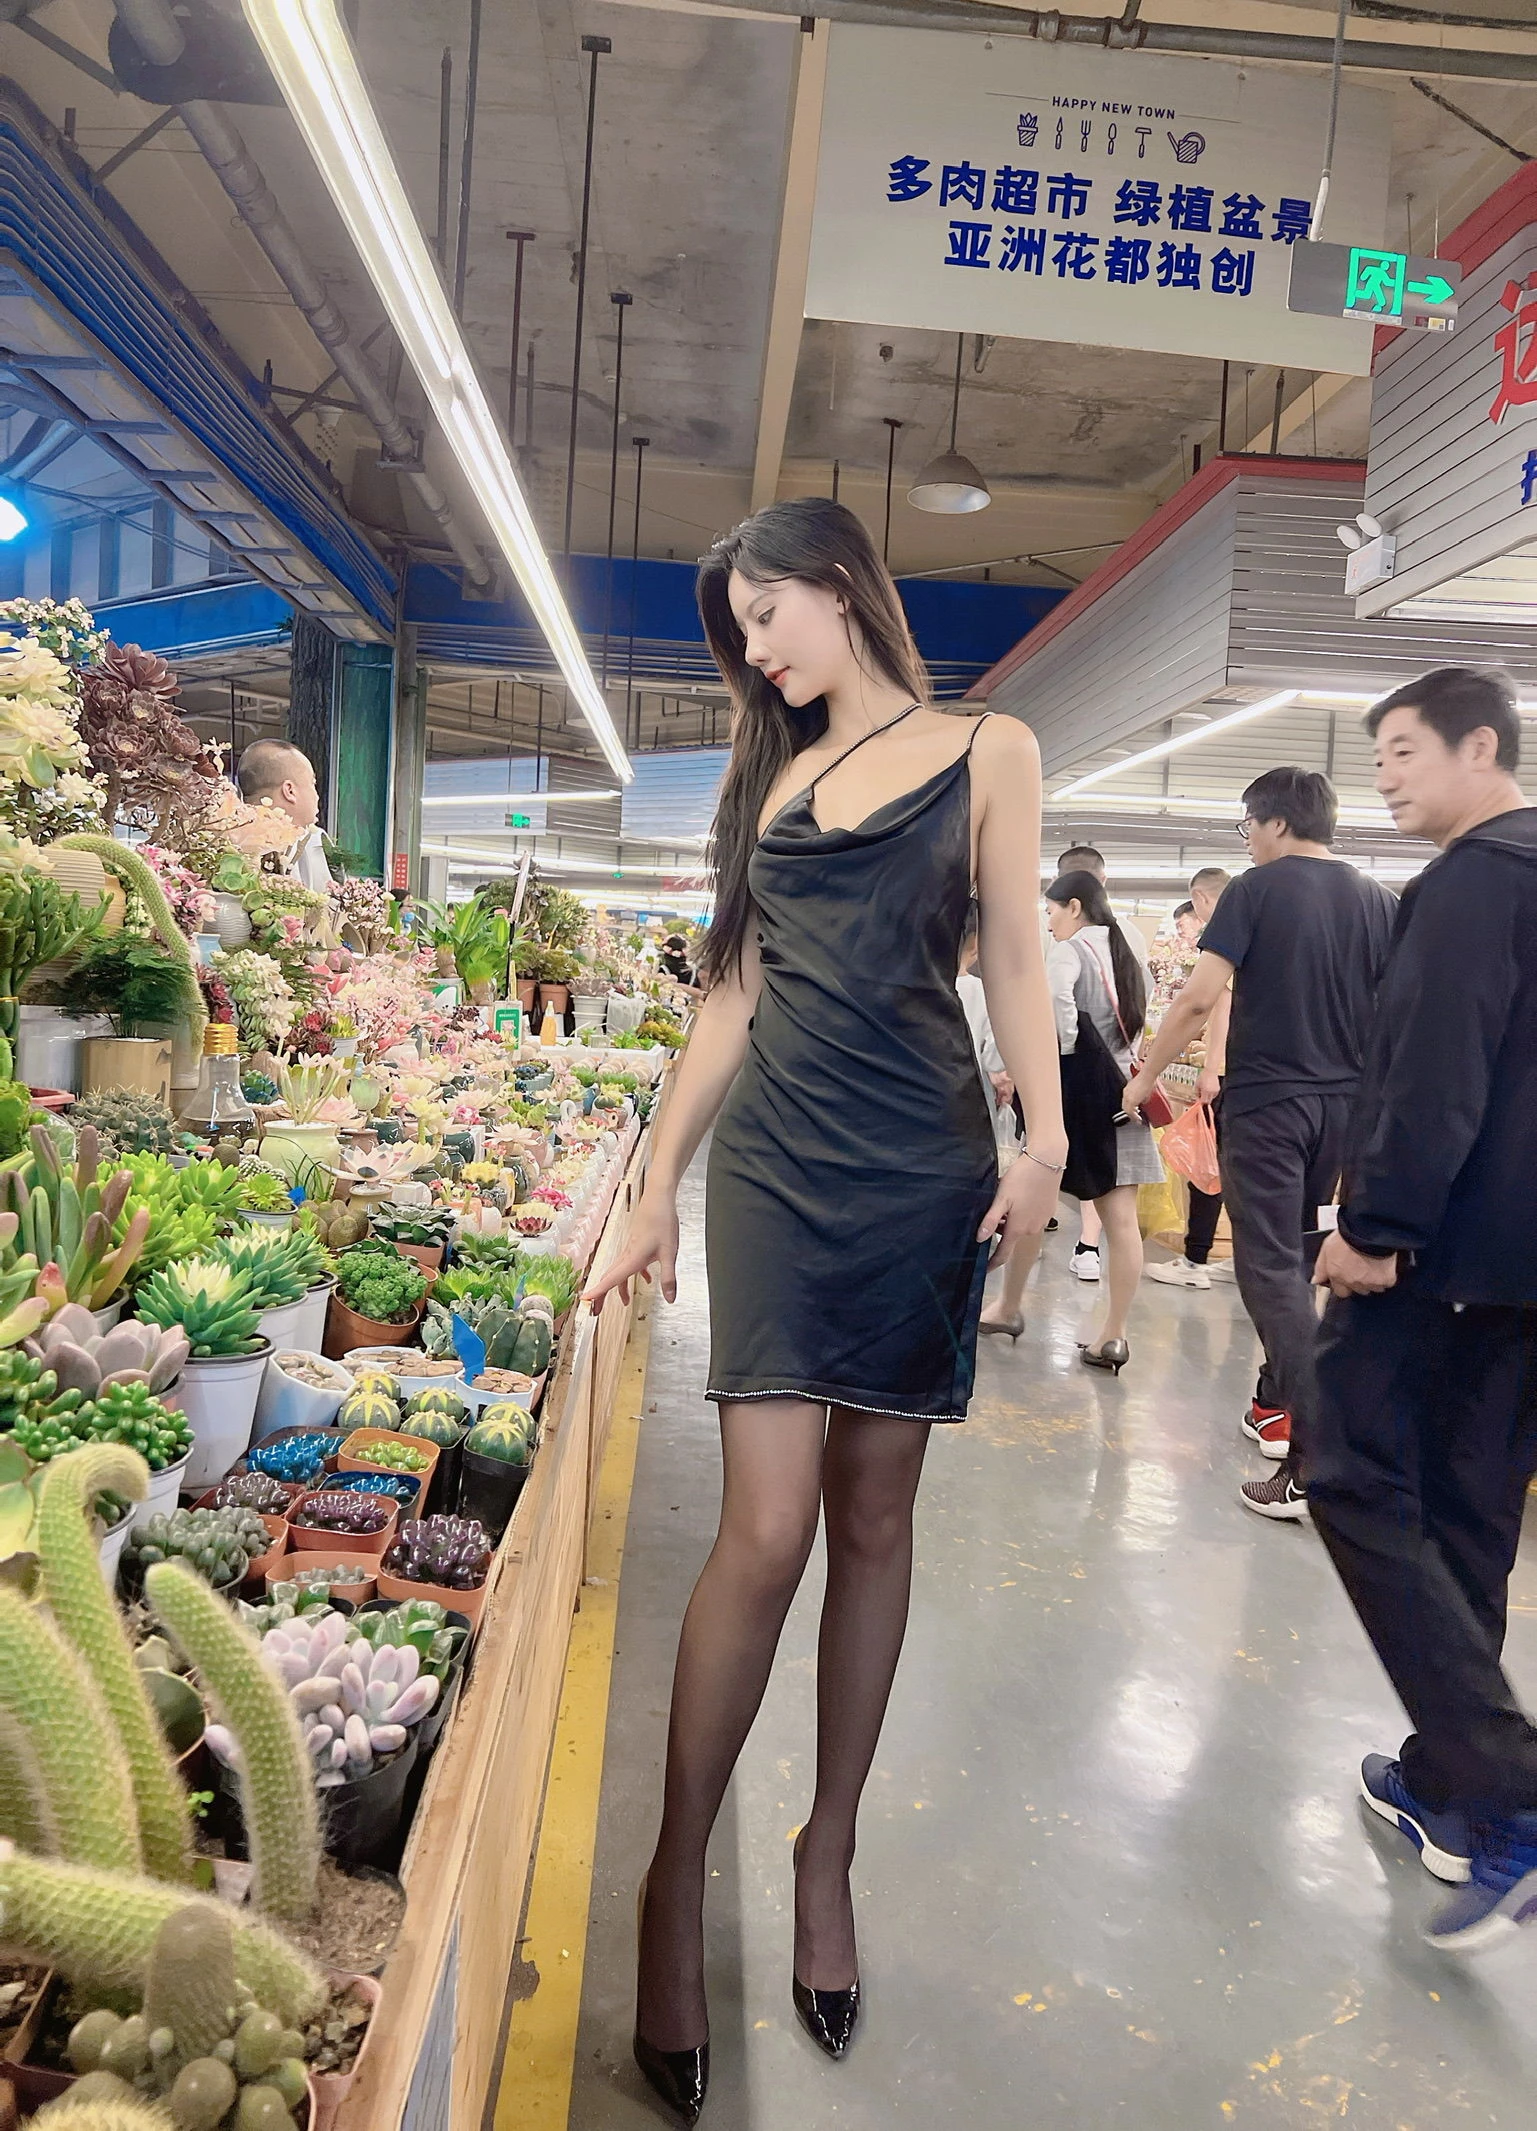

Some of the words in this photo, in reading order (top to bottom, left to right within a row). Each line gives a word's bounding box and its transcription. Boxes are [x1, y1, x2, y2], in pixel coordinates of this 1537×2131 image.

[1052, 96, 1097, 111] HAPPY
[1101, 102, 1132, 115] NEW
[1137, 105, 1175, 119] TOWN
[887, 155, 1093, 220] 多肉超市
[1113, 179, 1313, 245] 绿植盆景
[944, 219, 1256, 296] 亚洲花都独创
